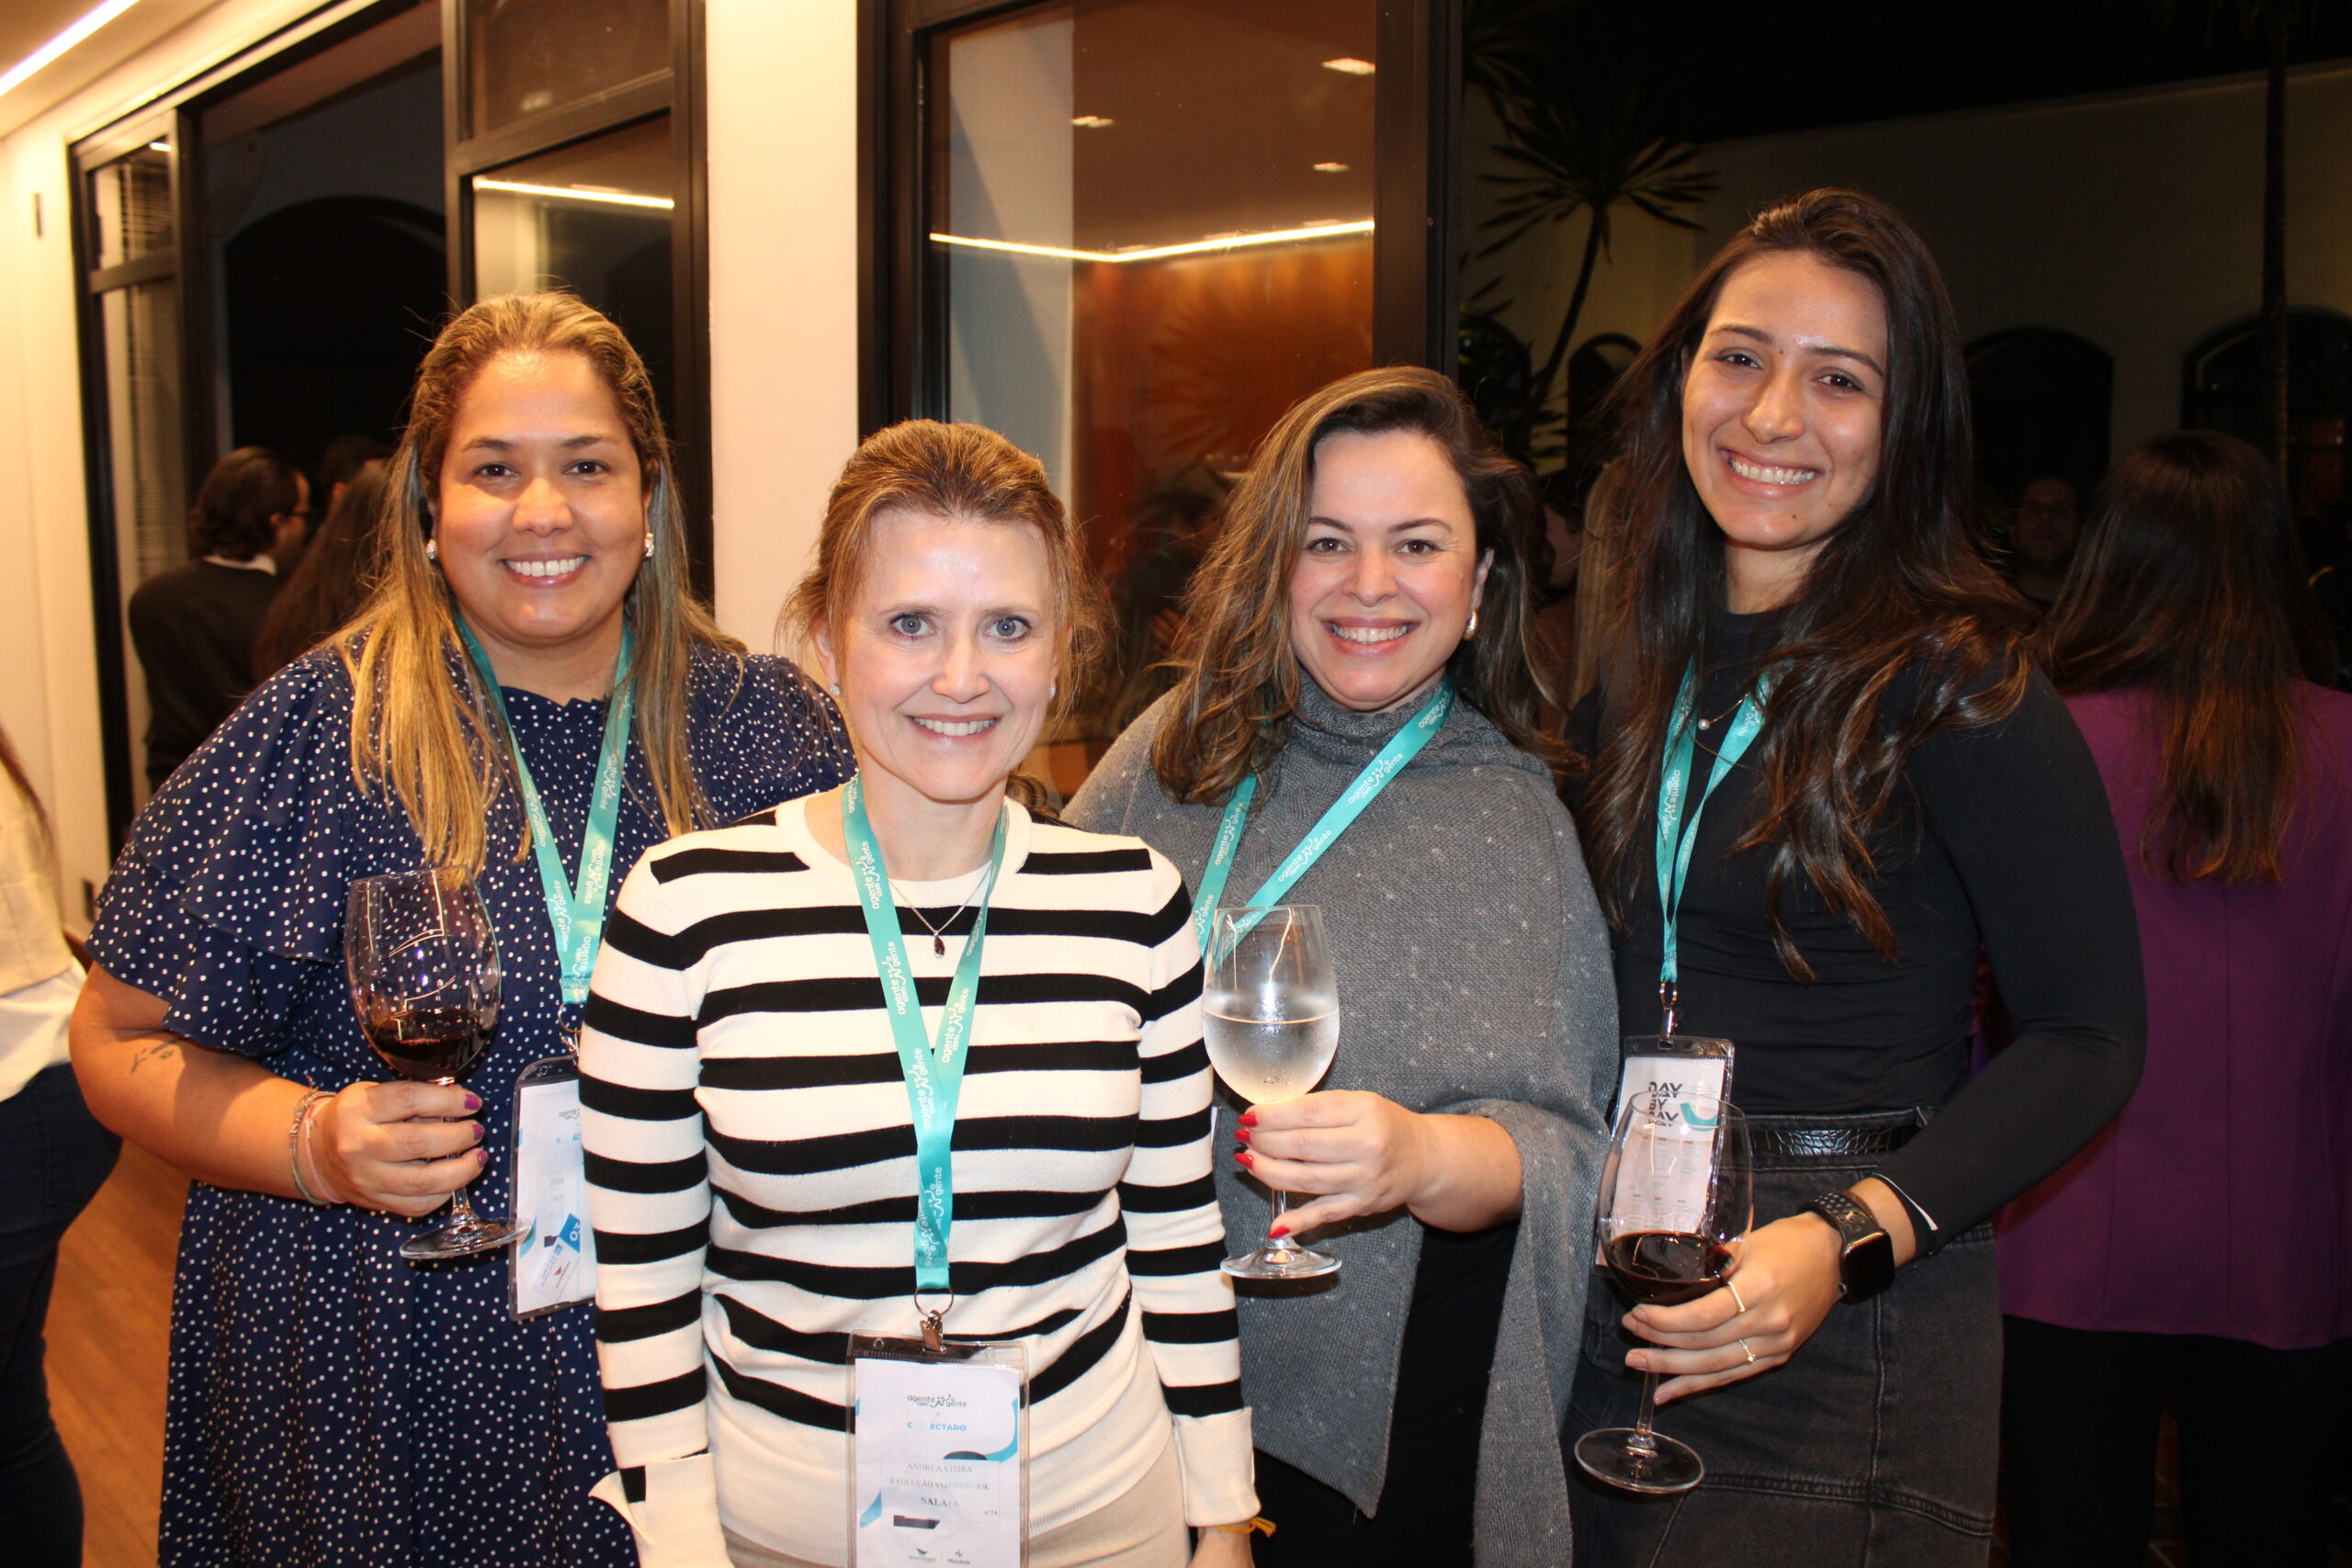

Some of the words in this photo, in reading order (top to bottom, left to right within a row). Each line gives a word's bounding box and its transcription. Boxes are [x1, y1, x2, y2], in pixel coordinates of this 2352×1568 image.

[1419, 705, 1440, 728] agente
[1348, 775, 1374, 804] agente
[1361, 785, 1373, 799] com
[1384, 752, 1404, 774] gente
[1670, 769, 1680, 803] agente
[862, 840, 876, 865] gente
[1215, 835, 1228, 865] agente
[1312, 829, 1332, 851] gente
[1278, 853, 1303, 882] agente
[554, 880, 567, 905] gente
[865, 877, 879, 909] agente
[1202, 895, 1214, 918] gente
[580, 936, 592, 972] agente
[887, 941, 901, 967] gente
[891, 978, 905, 1015] agente
[956, 987, 969, 1013] gente
[942, 1025, 956, 1063] agente
[914, 1048, 928, 1076] gente
[918, 1089, 933, 1130] agente
[934, 1167, 944, 1196] gente
[907, 1394, 935, 1403] agente
[907, 1462, 941, 1472] ANDREA
[943, 1464, 973, 1473] VIEIRA
